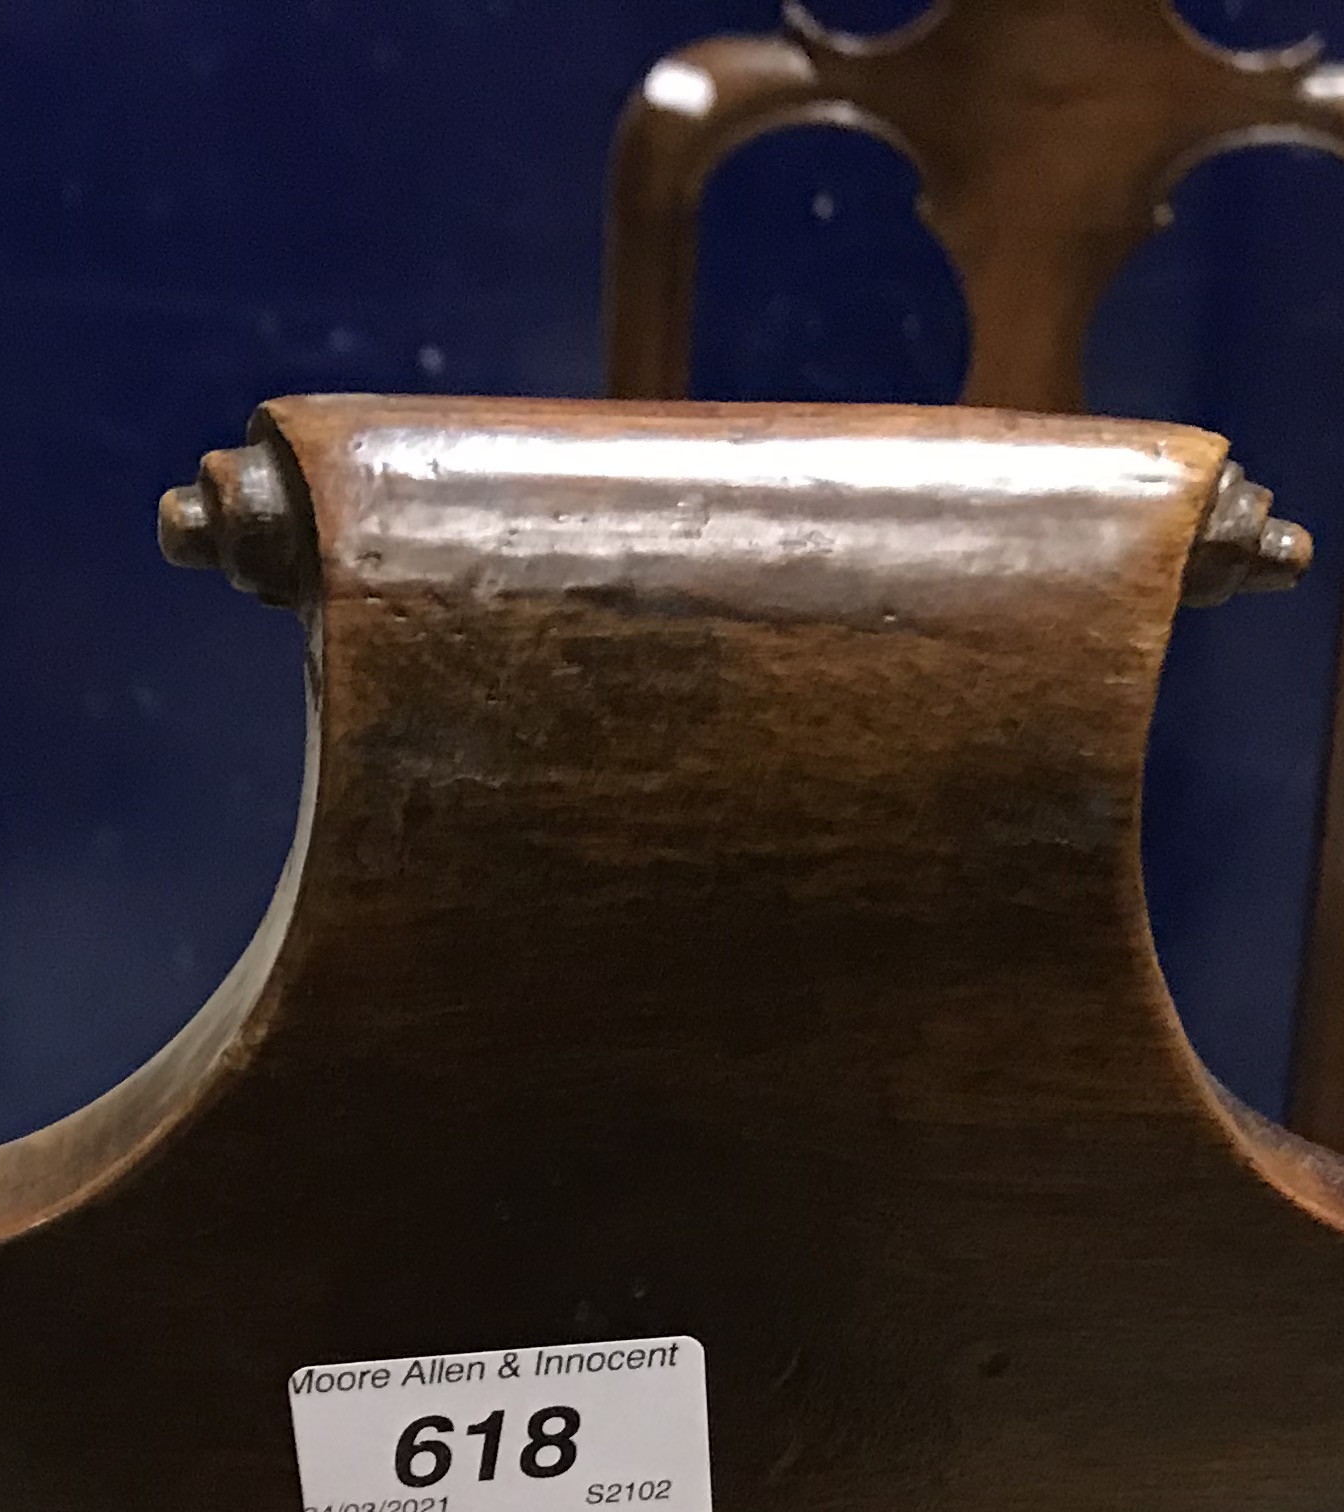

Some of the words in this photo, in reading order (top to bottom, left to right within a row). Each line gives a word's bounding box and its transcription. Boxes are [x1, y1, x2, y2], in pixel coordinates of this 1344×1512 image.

[402, 1358, 486, 1387] Allen
[497, 1352, 521, 1379] &
[536, 1342, 680, 1376] Innocent
[394, 1405, 582, 1488] 618
[585, 1479, 672, 1504] S2102
